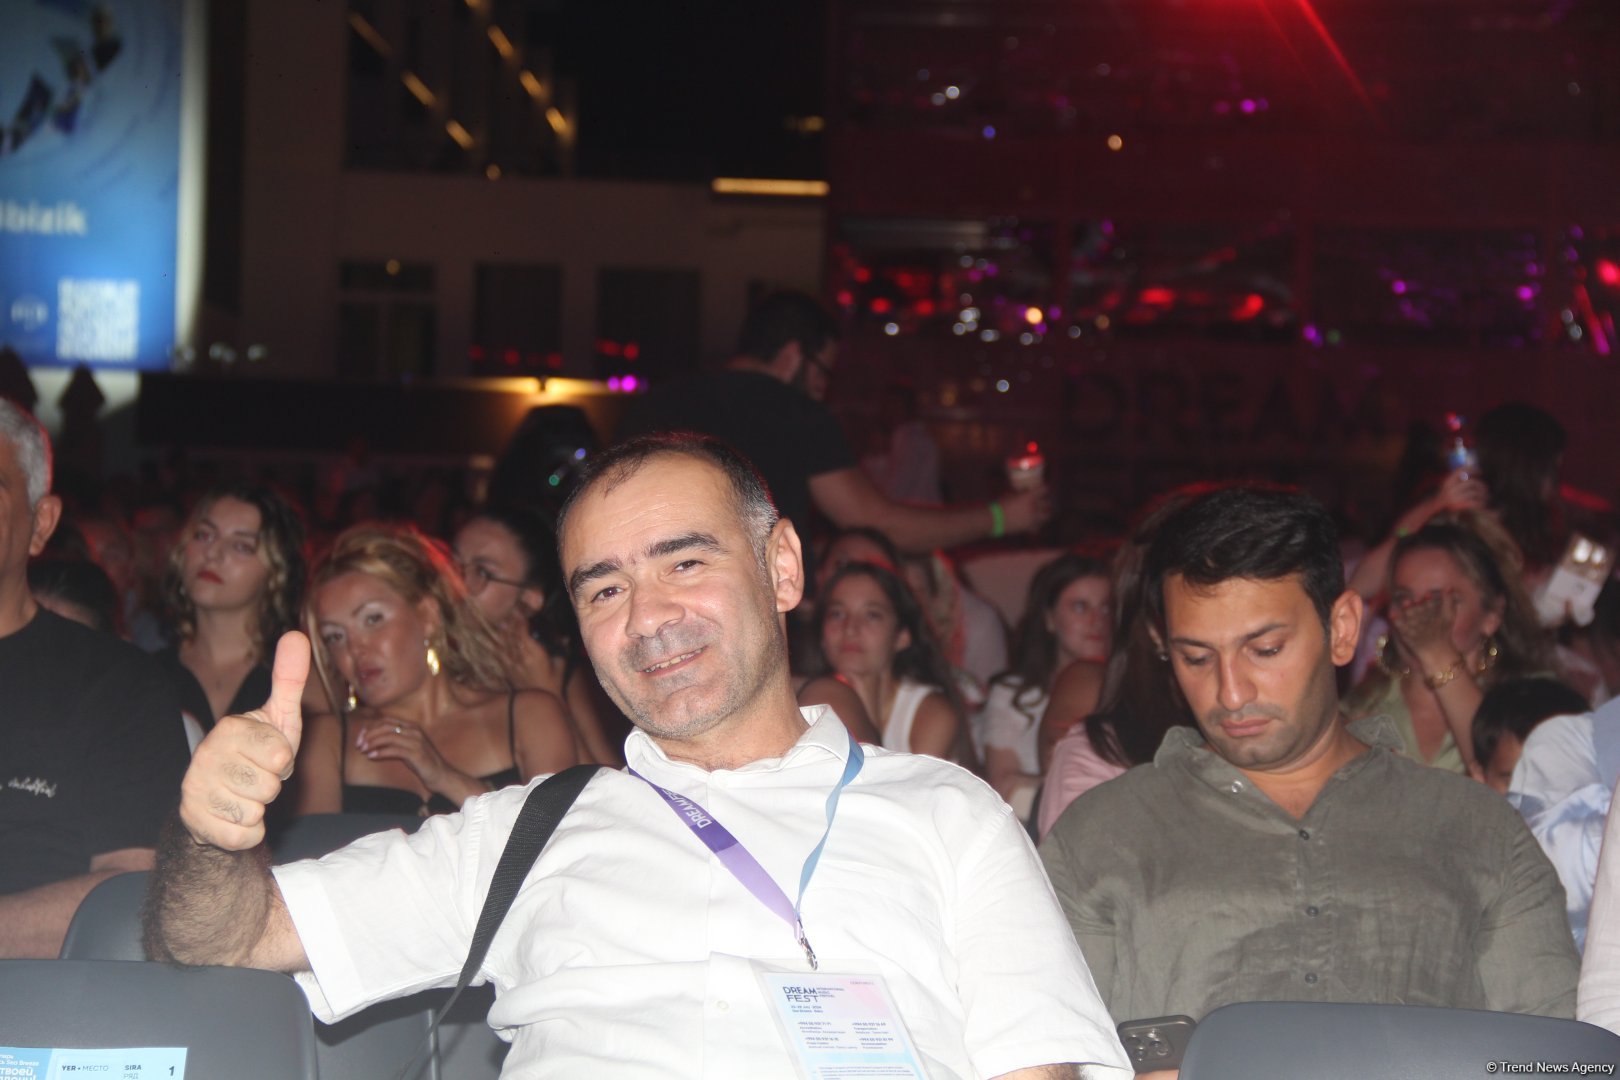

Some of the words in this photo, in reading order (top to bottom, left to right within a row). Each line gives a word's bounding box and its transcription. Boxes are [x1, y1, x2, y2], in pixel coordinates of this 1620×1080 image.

[782, 986, 818, 995] DREAM
[786, 994, 819, 1003] FEST
[169, 1065, 175, 1076] 1
